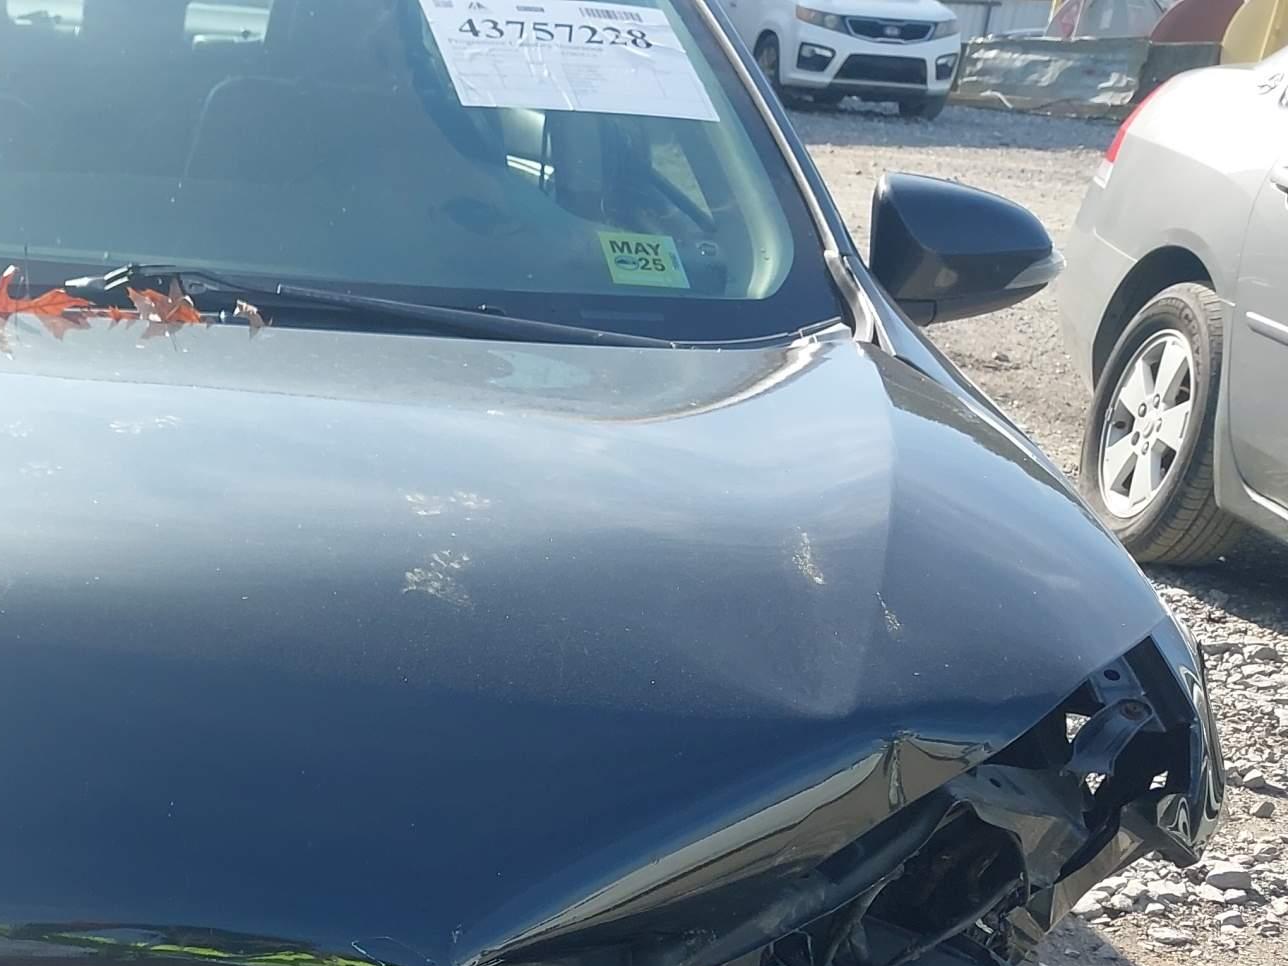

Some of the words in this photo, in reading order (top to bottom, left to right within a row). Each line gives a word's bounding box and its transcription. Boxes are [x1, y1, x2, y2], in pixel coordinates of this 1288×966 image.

[458, 18, 653, 49] 43757228
[608, 239, 660, 256] MAY
[638, 257, 666, 272] 25
